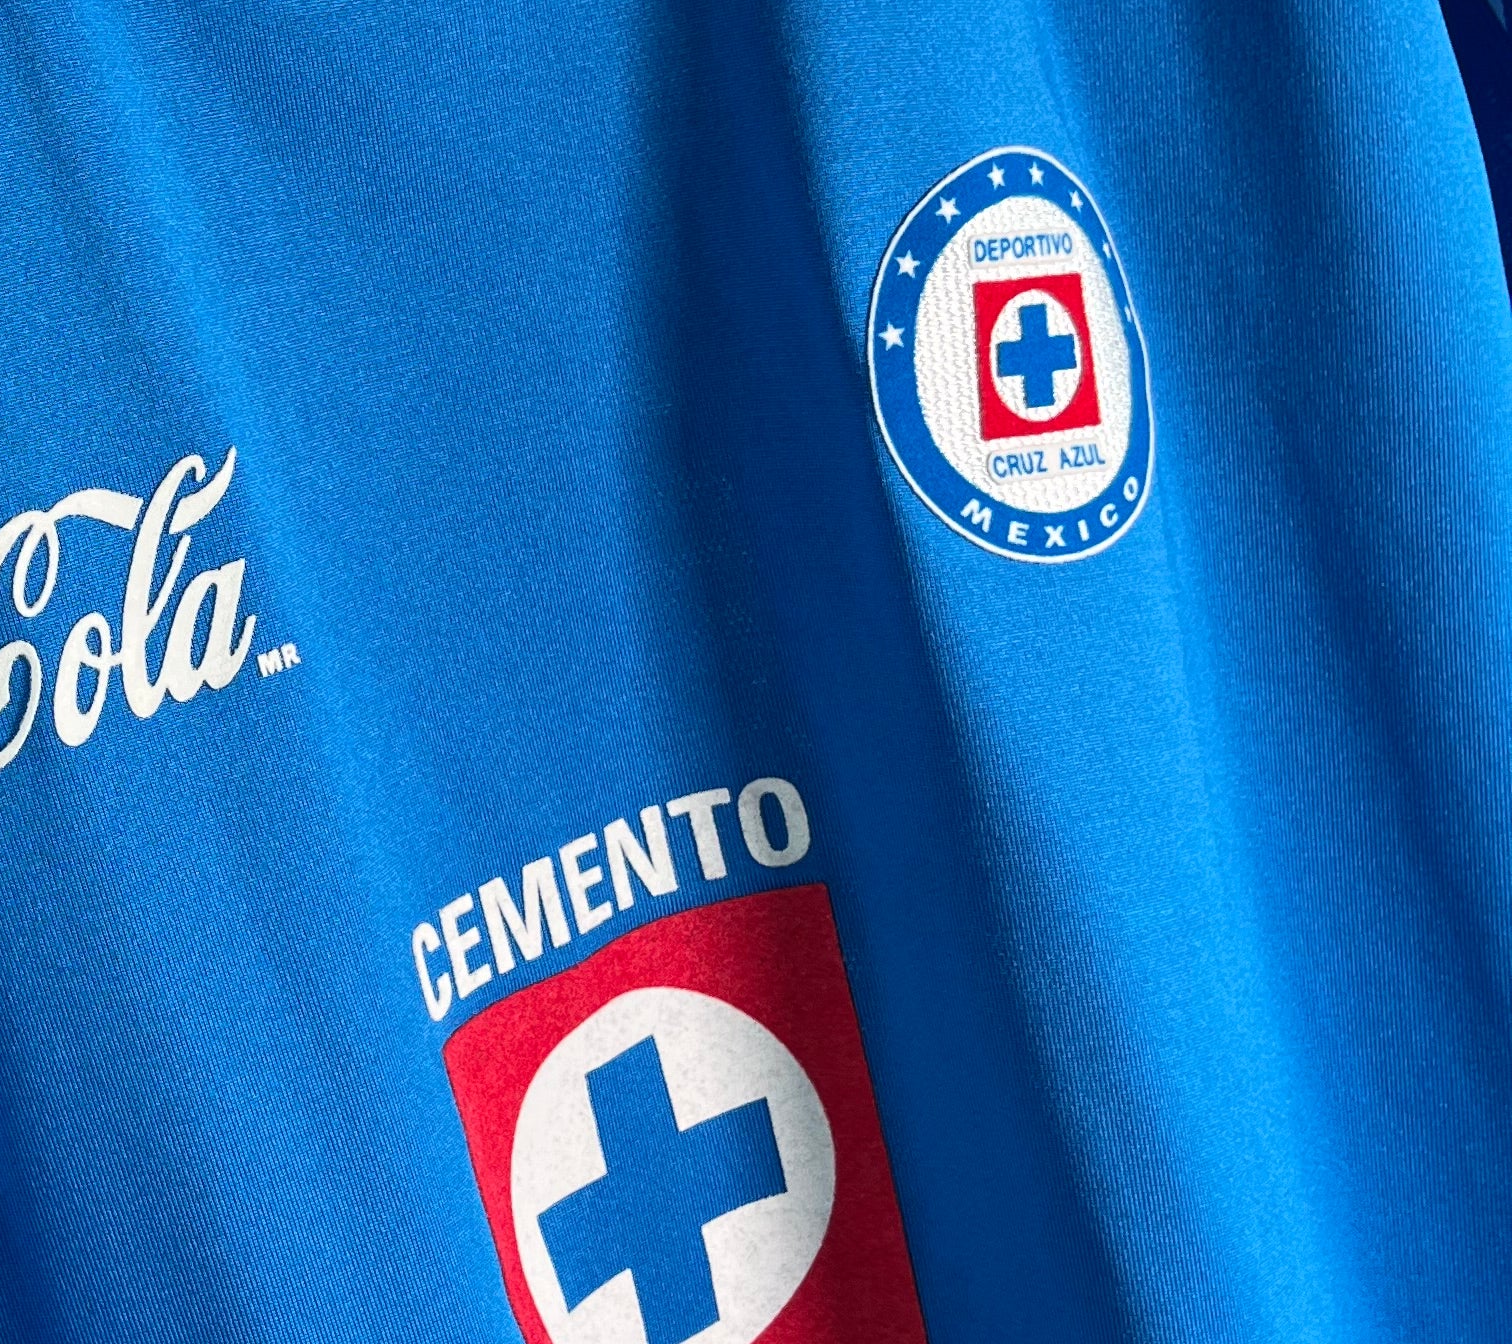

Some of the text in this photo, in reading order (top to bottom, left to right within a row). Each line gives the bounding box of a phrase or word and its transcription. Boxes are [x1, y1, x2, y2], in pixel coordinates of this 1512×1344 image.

[973, 232, 1073, 263] DEPORTIVO
[992, 443, 1106, 479] CRUZ AZUL
[959, 475, 1140, 549] MEXICO
[257, 642, 301, 678] MR
[410, 776, 812, 1022] CEMENTO
